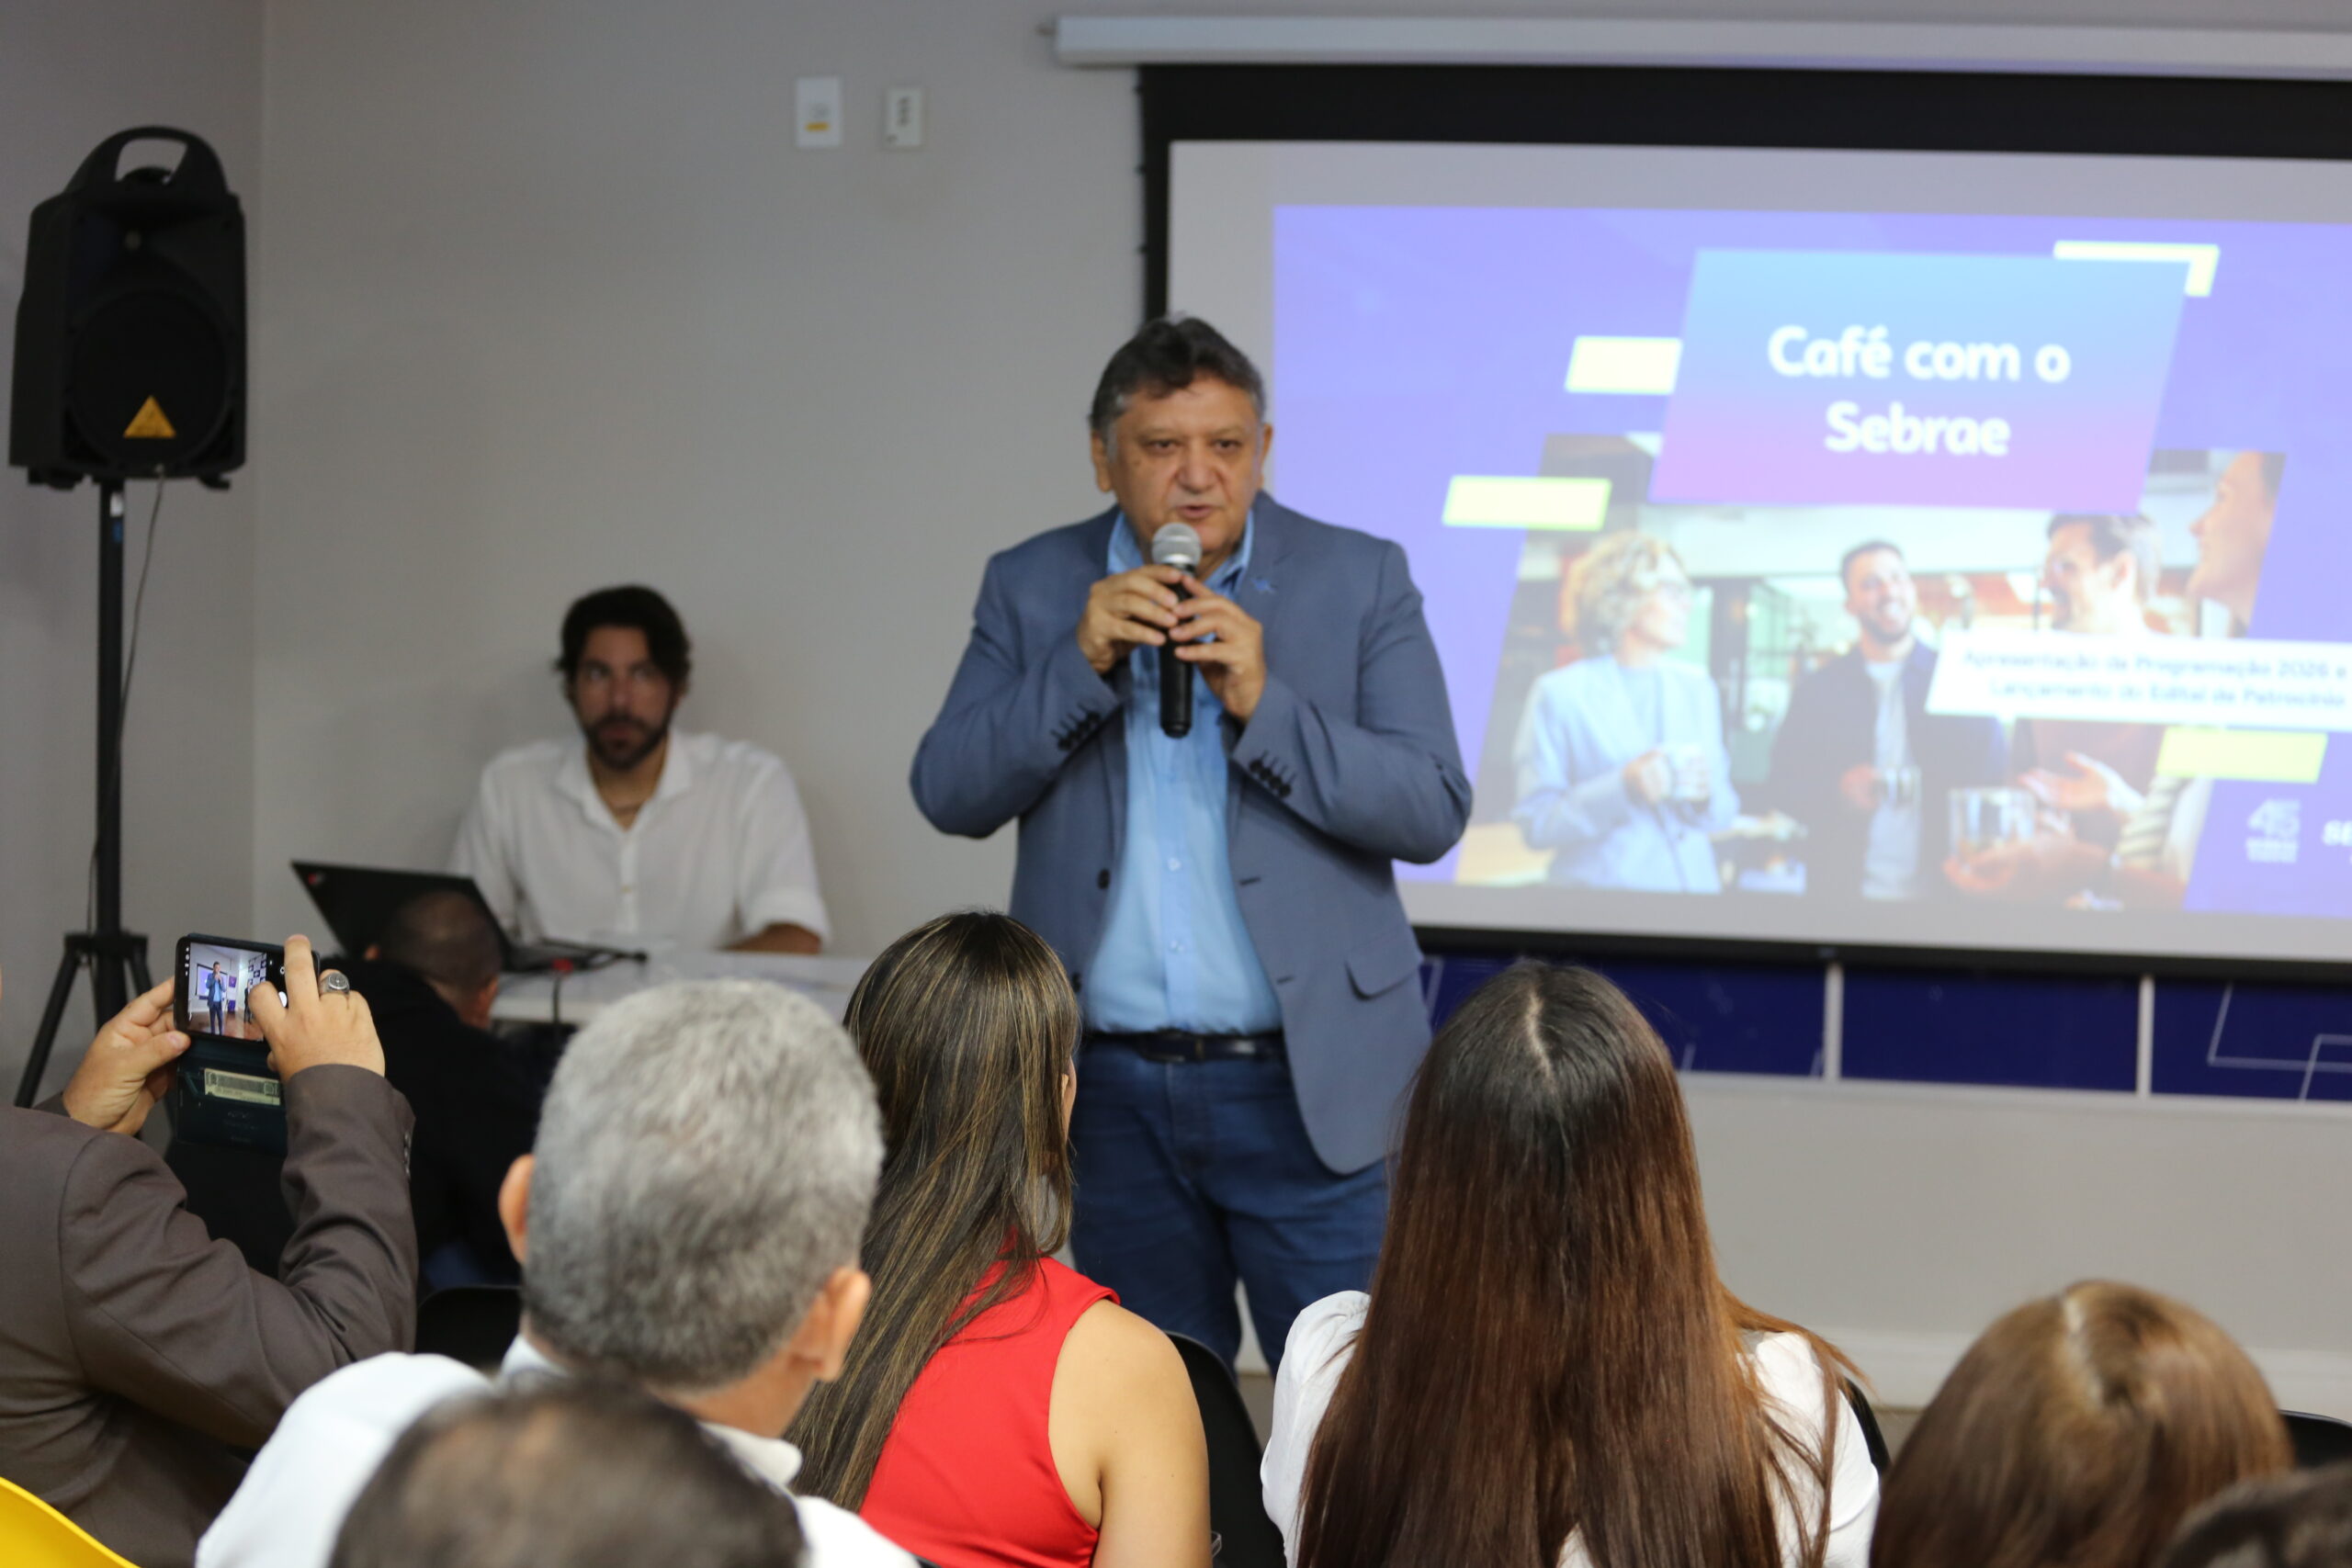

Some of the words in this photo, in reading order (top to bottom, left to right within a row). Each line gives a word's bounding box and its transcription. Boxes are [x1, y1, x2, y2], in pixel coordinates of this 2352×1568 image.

[1768, 324, 1893, 378] Café
[1905, 341, 2021, 380] com
[2034, 344, 2071, 382] o
[1824, 400, 2010, 456] Sebrae
